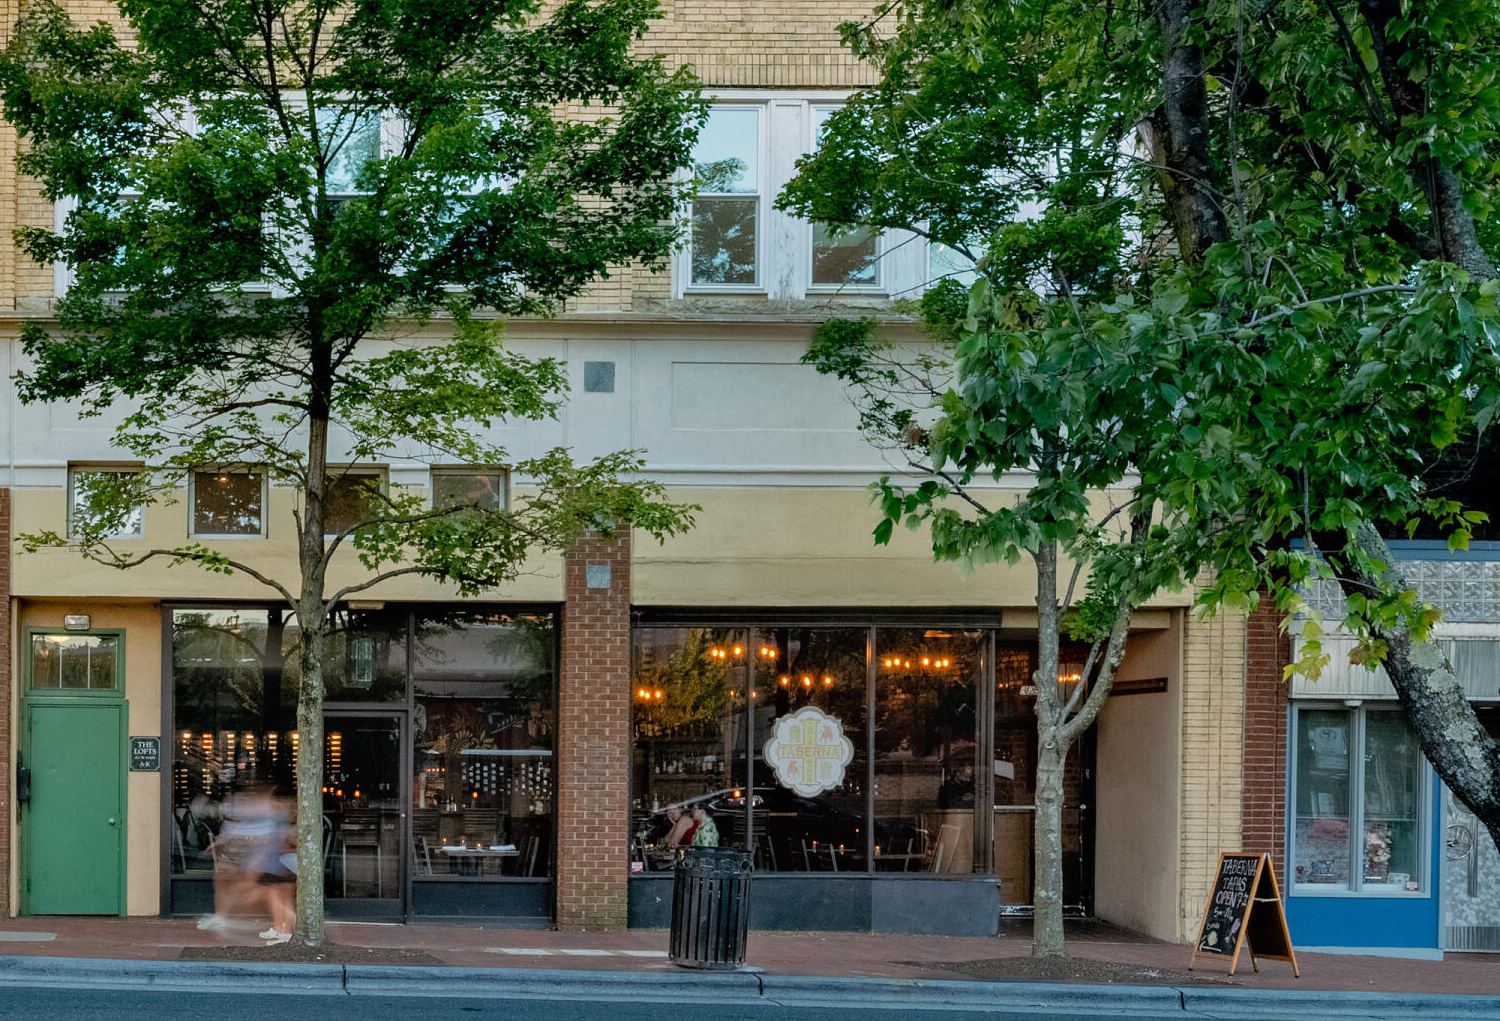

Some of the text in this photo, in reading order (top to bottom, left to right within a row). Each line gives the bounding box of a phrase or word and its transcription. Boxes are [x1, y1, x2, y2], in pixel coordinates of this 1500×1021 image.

[780, 746, 839, 757] TABERNA
[1222, 859, 1258, 876] TABERNA
[1223, 876, 1248, 892] TAPAS
[1215, 890, 1237, 908] OPEN
